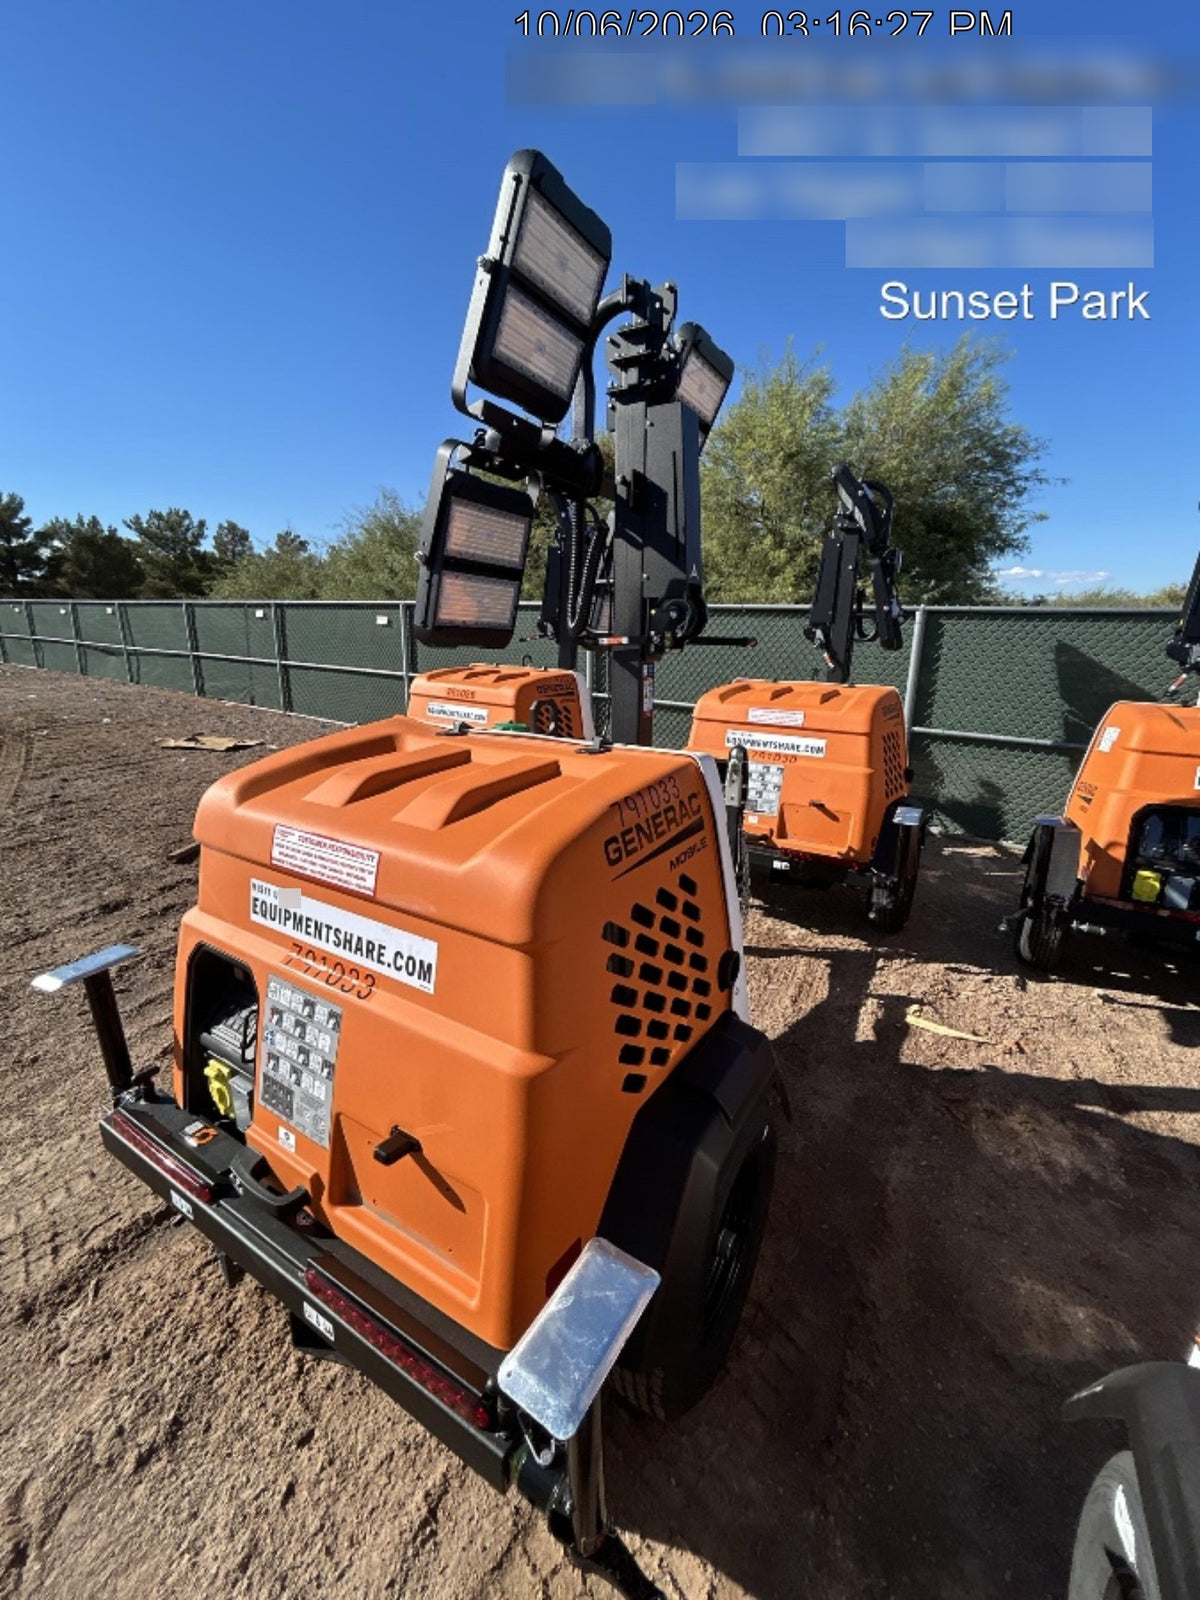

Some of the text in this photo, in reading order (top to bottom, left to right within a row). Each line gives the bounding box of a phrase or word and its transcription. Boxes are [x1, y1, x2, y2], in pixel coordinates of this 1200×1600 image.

[603, 792, 701, 867] GENERAC
[609, 775, 680, 827] 791033
[669, 836, 708, 873] MOBILE
[252, 897, 433, 984] EQUIPMENTSHARE.COM
[284, 942, 376, 1000] 791033
